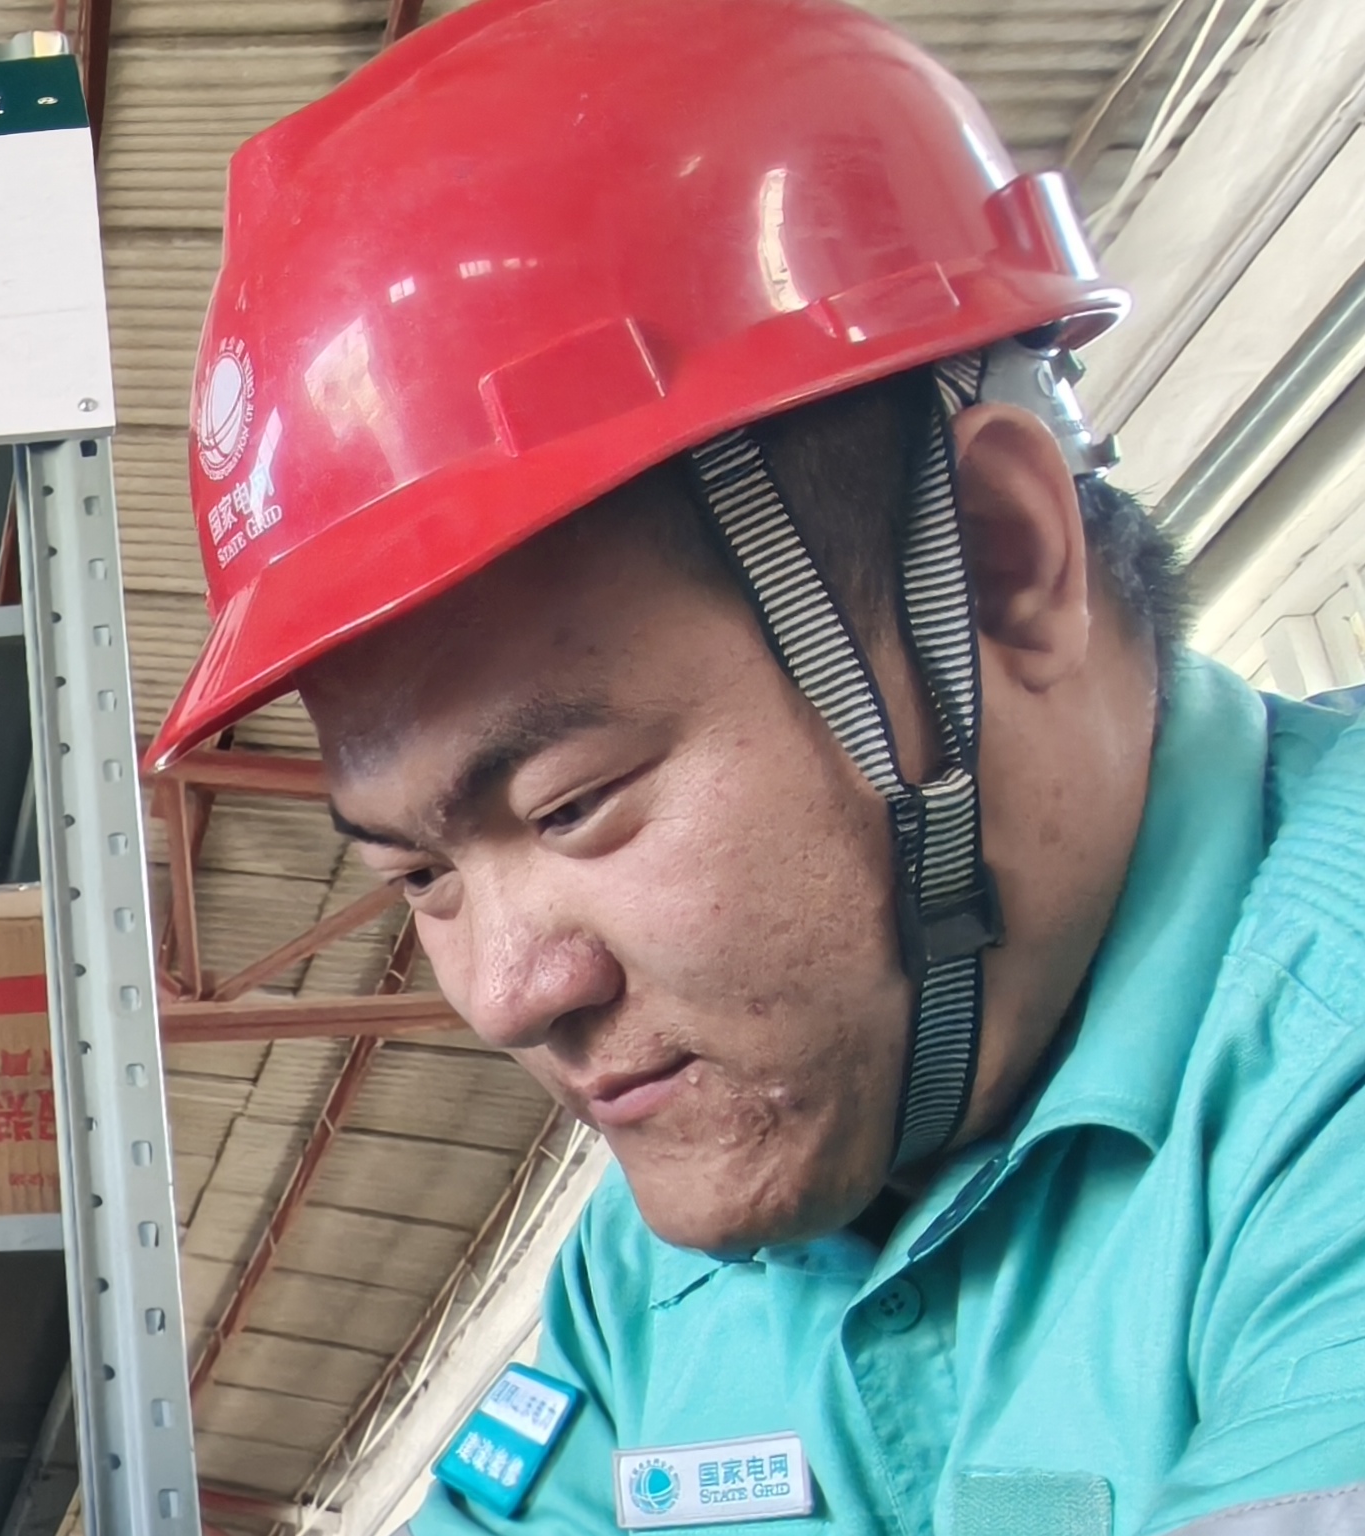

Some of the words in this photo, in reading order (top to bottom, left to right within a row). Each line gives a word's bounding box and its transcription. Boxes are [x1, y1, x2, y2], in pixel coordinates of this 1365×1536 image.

[216, 530, 247, 570] STATE
[698, 1453, 789, 1487] 国家电网
[699, 1487, 748, 1505] STATE
[752, 1481, 791, 1498] GRID
